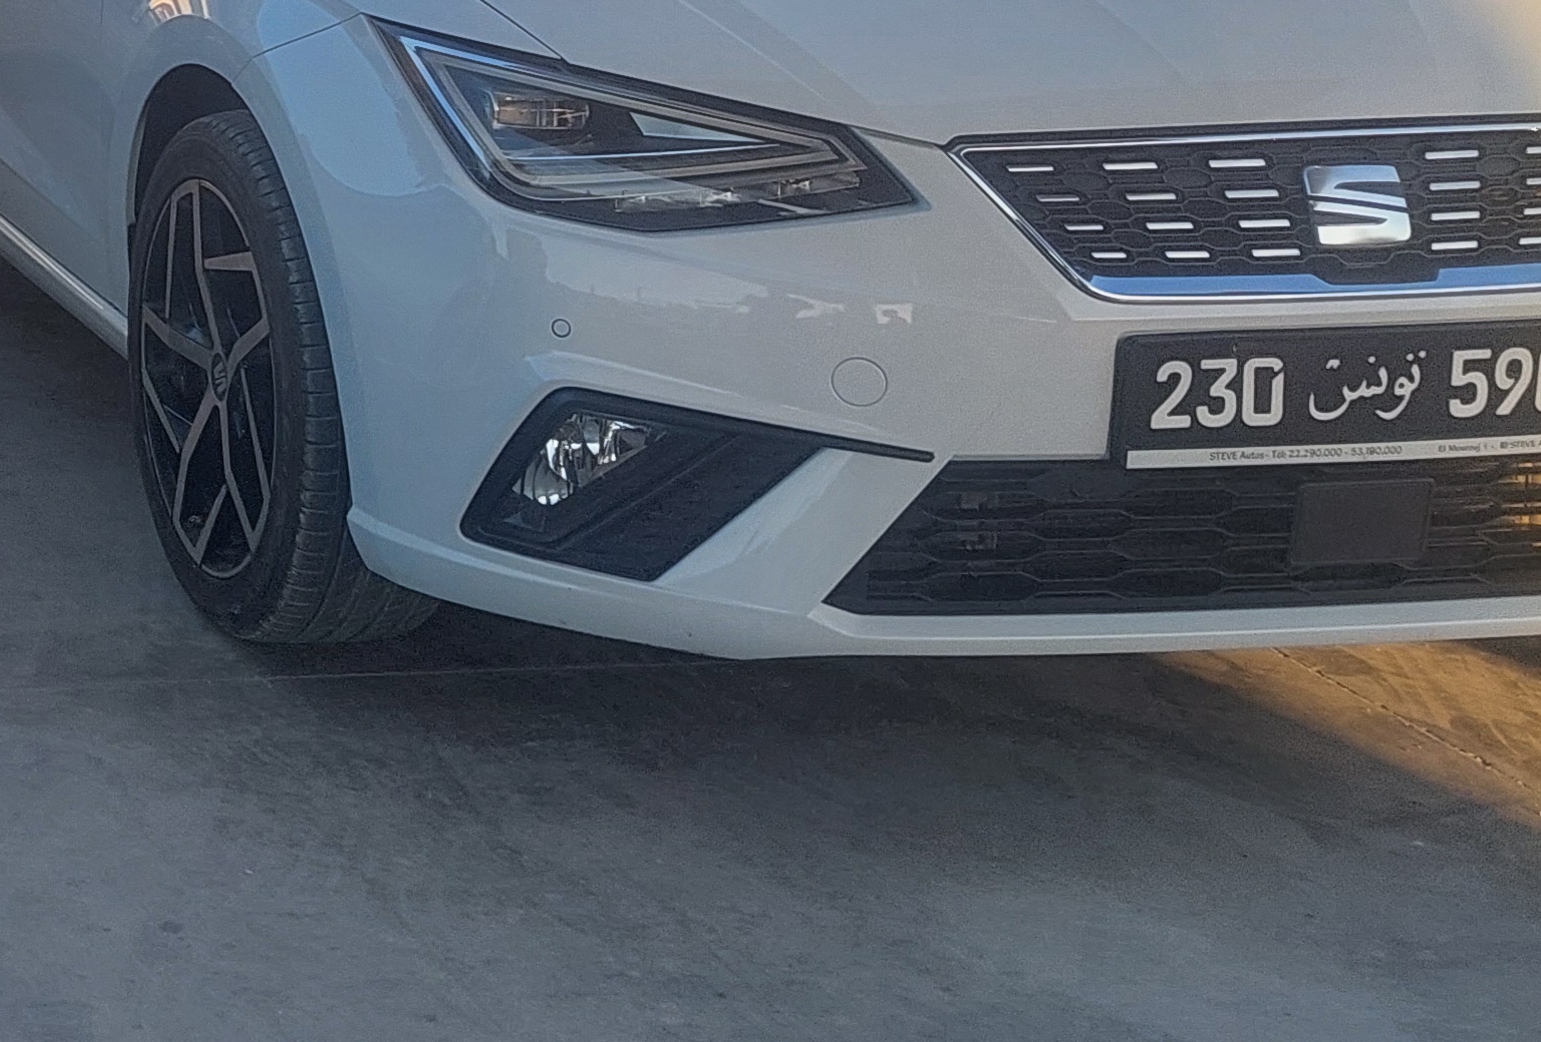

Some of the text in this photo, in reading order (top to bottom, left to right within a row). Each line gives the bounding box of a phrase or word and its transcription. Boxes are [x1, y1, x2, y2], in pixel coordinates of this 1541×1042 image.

[1150, 347, 1541, 430] 230 تونس 59
